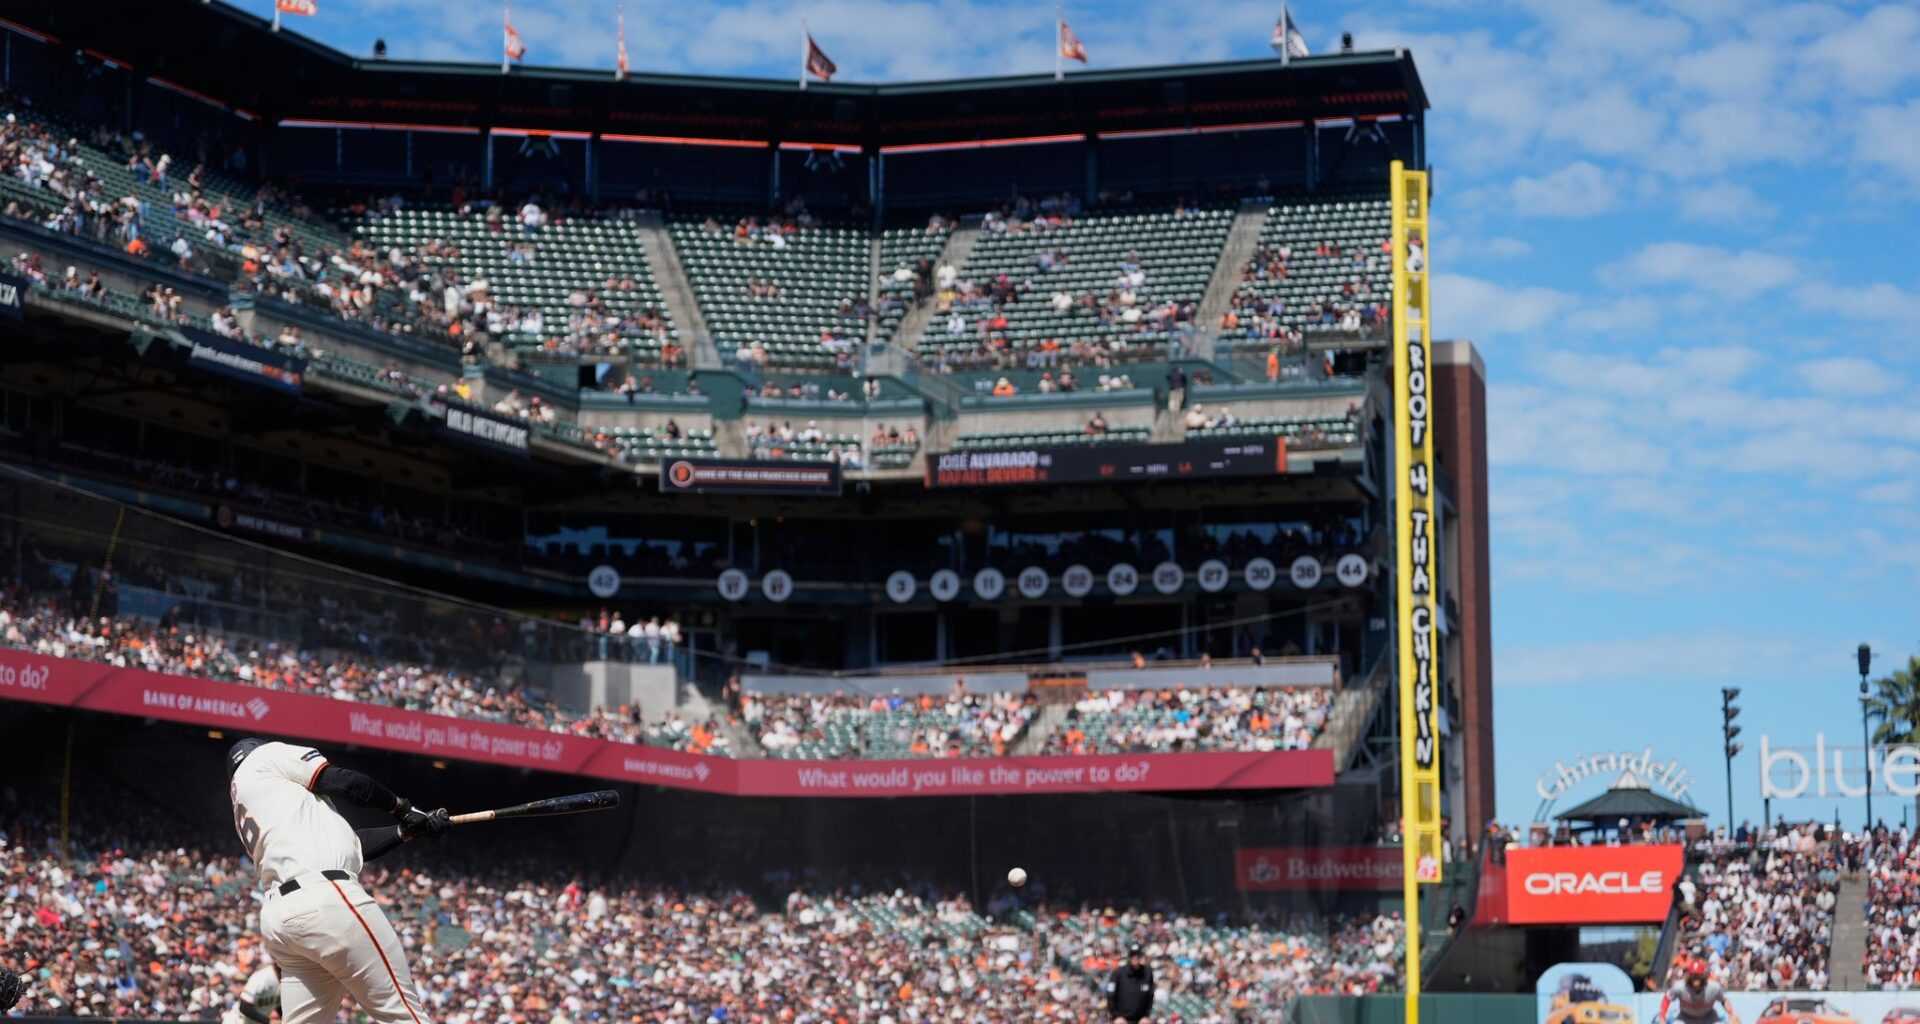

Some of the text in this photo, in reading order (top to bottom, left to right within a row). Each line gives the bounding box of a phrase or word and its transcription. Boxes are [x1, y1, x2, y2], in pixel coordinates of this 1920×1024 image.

[473, 416, 527, 449] NETWORK
[938, 450, 968, 470] JOSÉ
[969, 451, 1038, 469] ALVARADO
[938, 467, 986, 485] RAFAEL
[987, 466, 1036, 482] DEVERS
[1409, 344, 1433, 764] ROOT 4 THA CHIKIN
[0, 663, 49, 690] to do?
[143, 689, 245, 717] BANK OF AMERICA
[349, 711, 563, 761] What would you like the power to do?
[624, 758, 694, 780] BANK OF AMERICA
[798, 761, 1149, 792] What would you like the power to do?
[1537, 748, 1695, 800] Ghirardelli
[1759, 732, 1920, 799] blue
[1524, 871, 1663, 895] ORACLE
